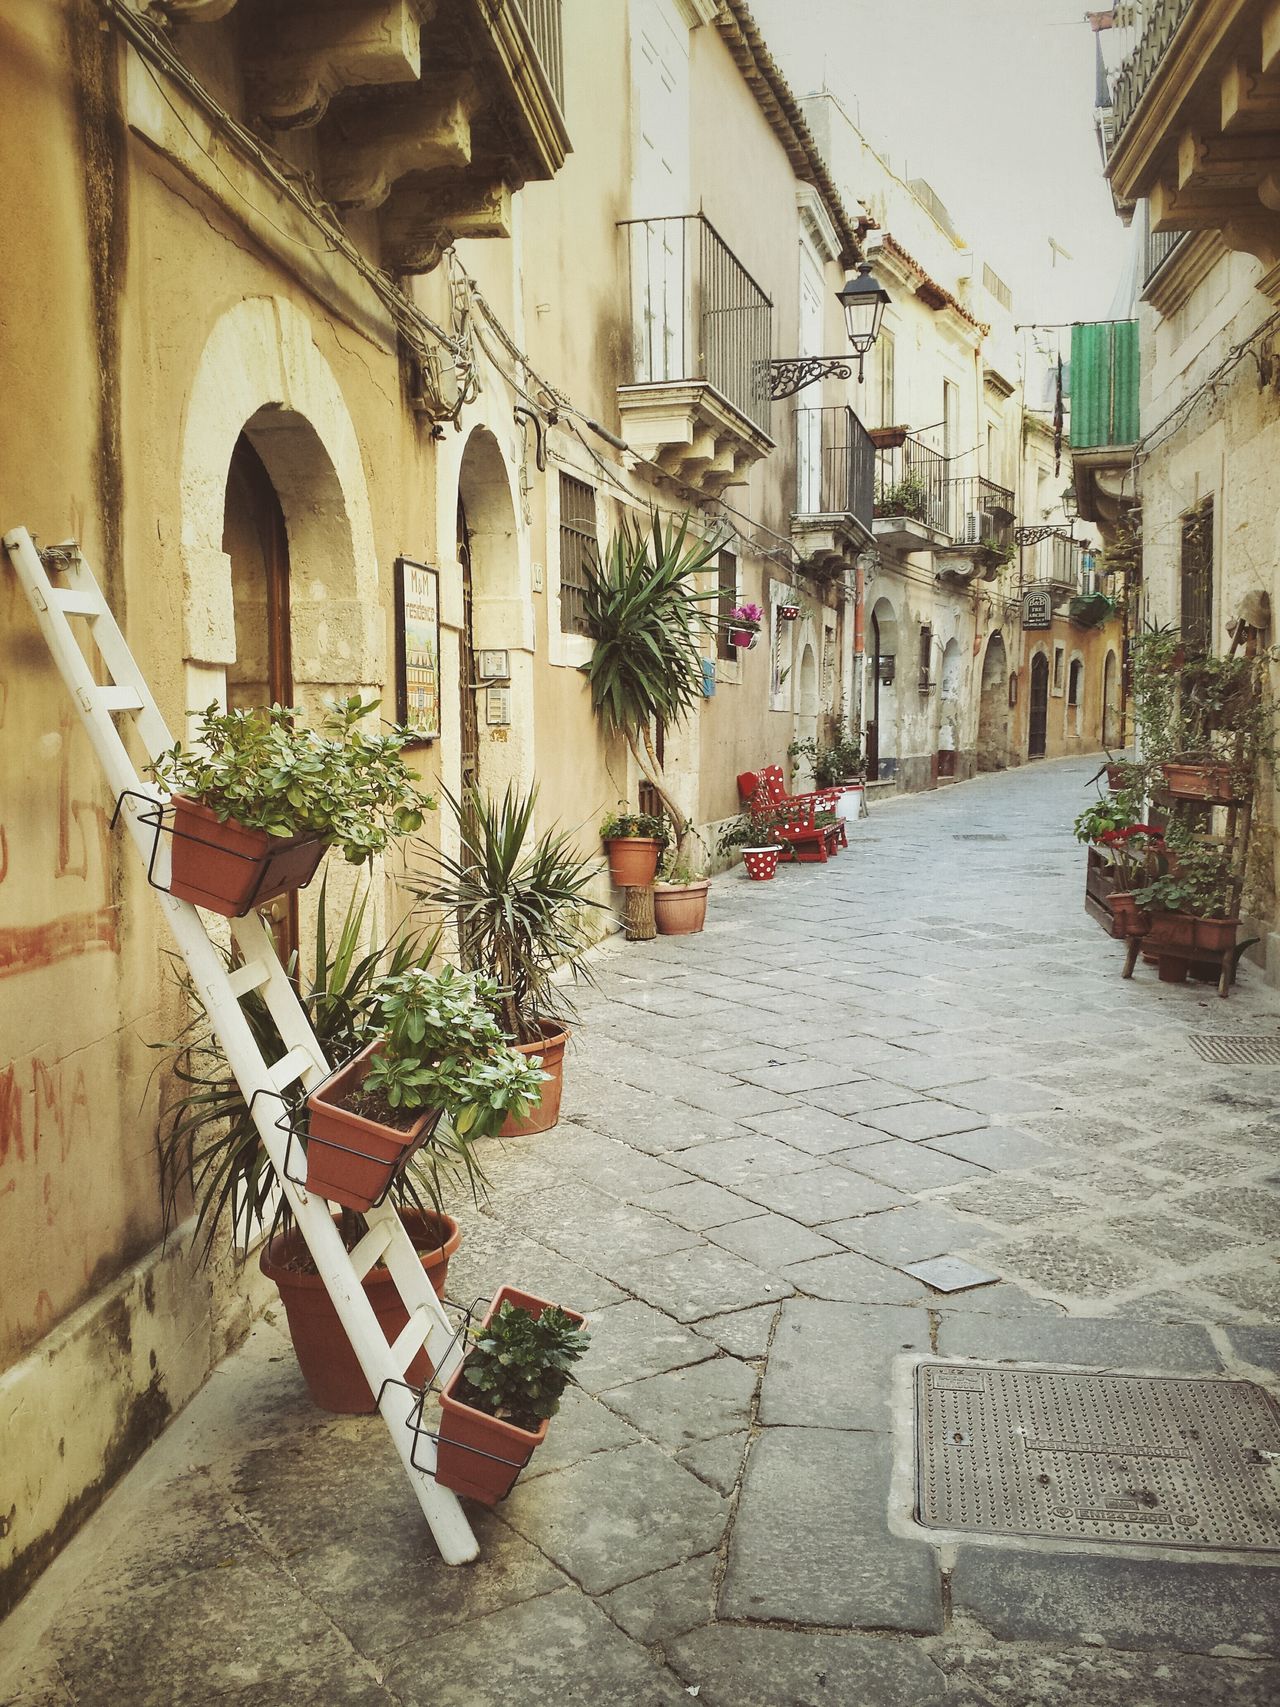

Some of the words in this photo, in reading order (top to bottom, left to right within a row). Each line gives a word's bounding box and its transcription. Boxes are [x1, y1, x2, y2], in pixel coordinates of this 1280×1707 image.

[411, 570, 429, 597] M&M
[1029, 597, 1045, 606] B&B
[405, 599, 434, 622] residence
[1125, 1447, 1189, 1457] SIRACUSA
